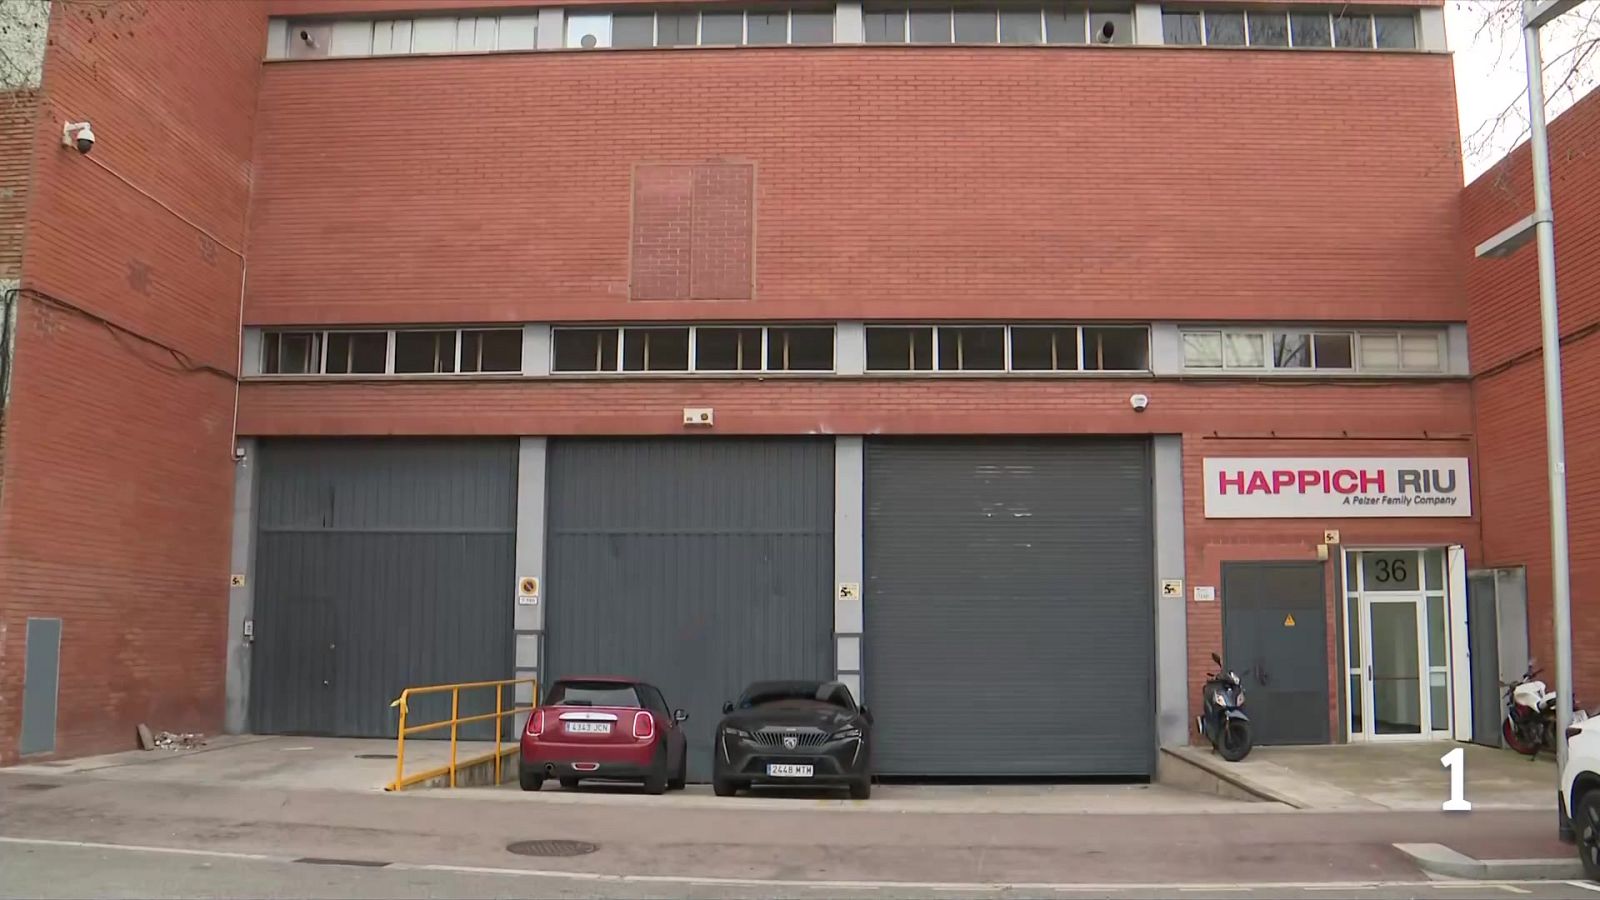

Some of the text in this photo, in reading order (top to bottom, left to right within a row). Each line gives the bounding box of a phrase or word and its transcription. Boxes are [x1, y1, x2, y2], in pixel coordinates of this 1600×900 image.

[1219, 469, 1456, 495] HAPPICH RIU
[1342, 494, 1457, 507] A Pelzer Family Company
[1375, 558, 1407, 583] 36
[772, 765, 793, 774] 2448
